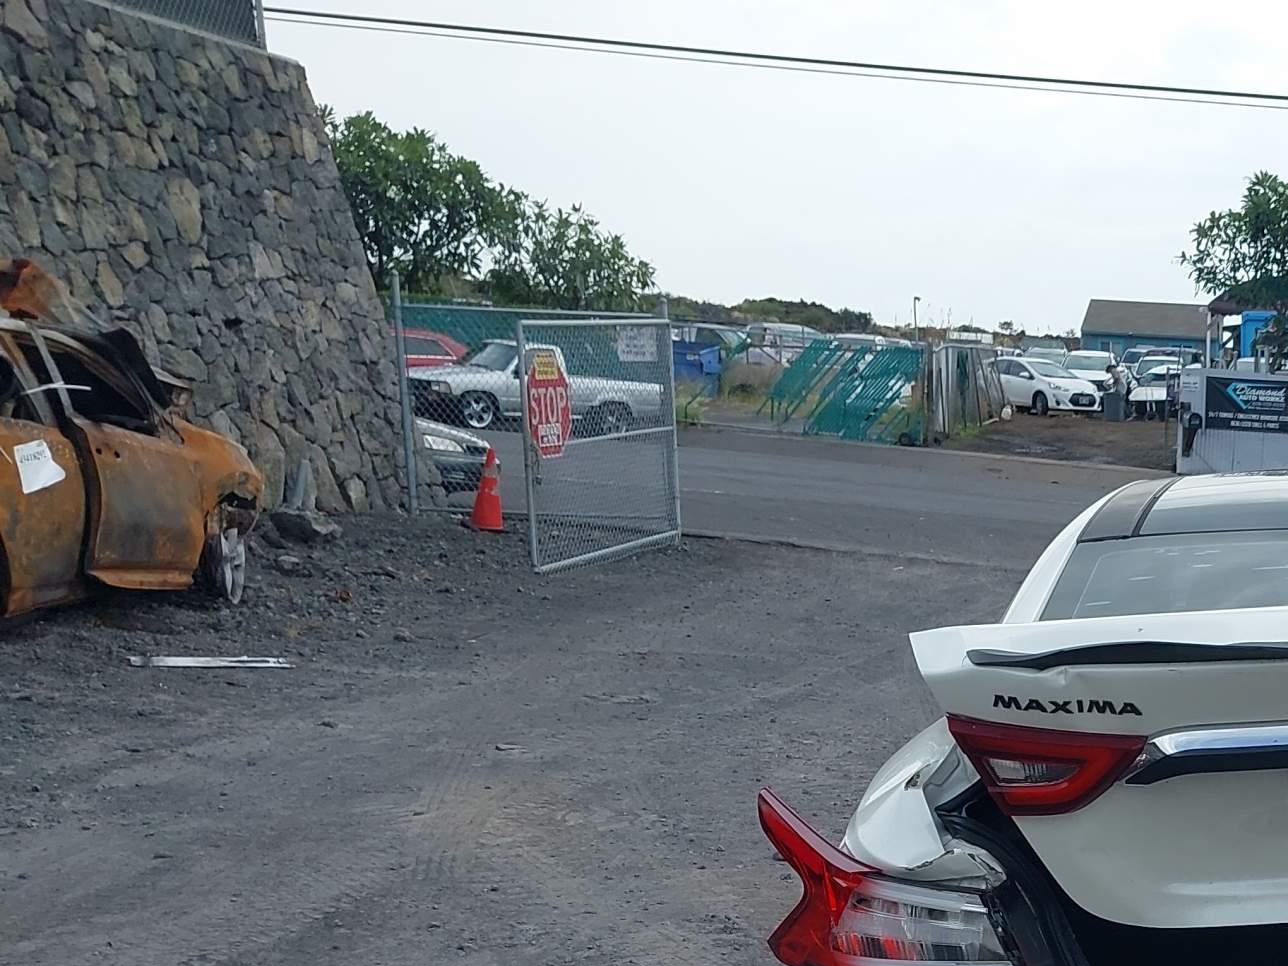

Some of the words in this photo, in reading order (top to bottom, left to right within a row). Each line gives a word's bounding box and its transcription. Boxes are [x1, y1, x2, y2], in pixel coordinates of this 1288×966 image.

[1236, 384, 1287, 397] Diamond
[530, 386, 567, 426] STOP
[992, 694, 1143, 716] MAXIMA
